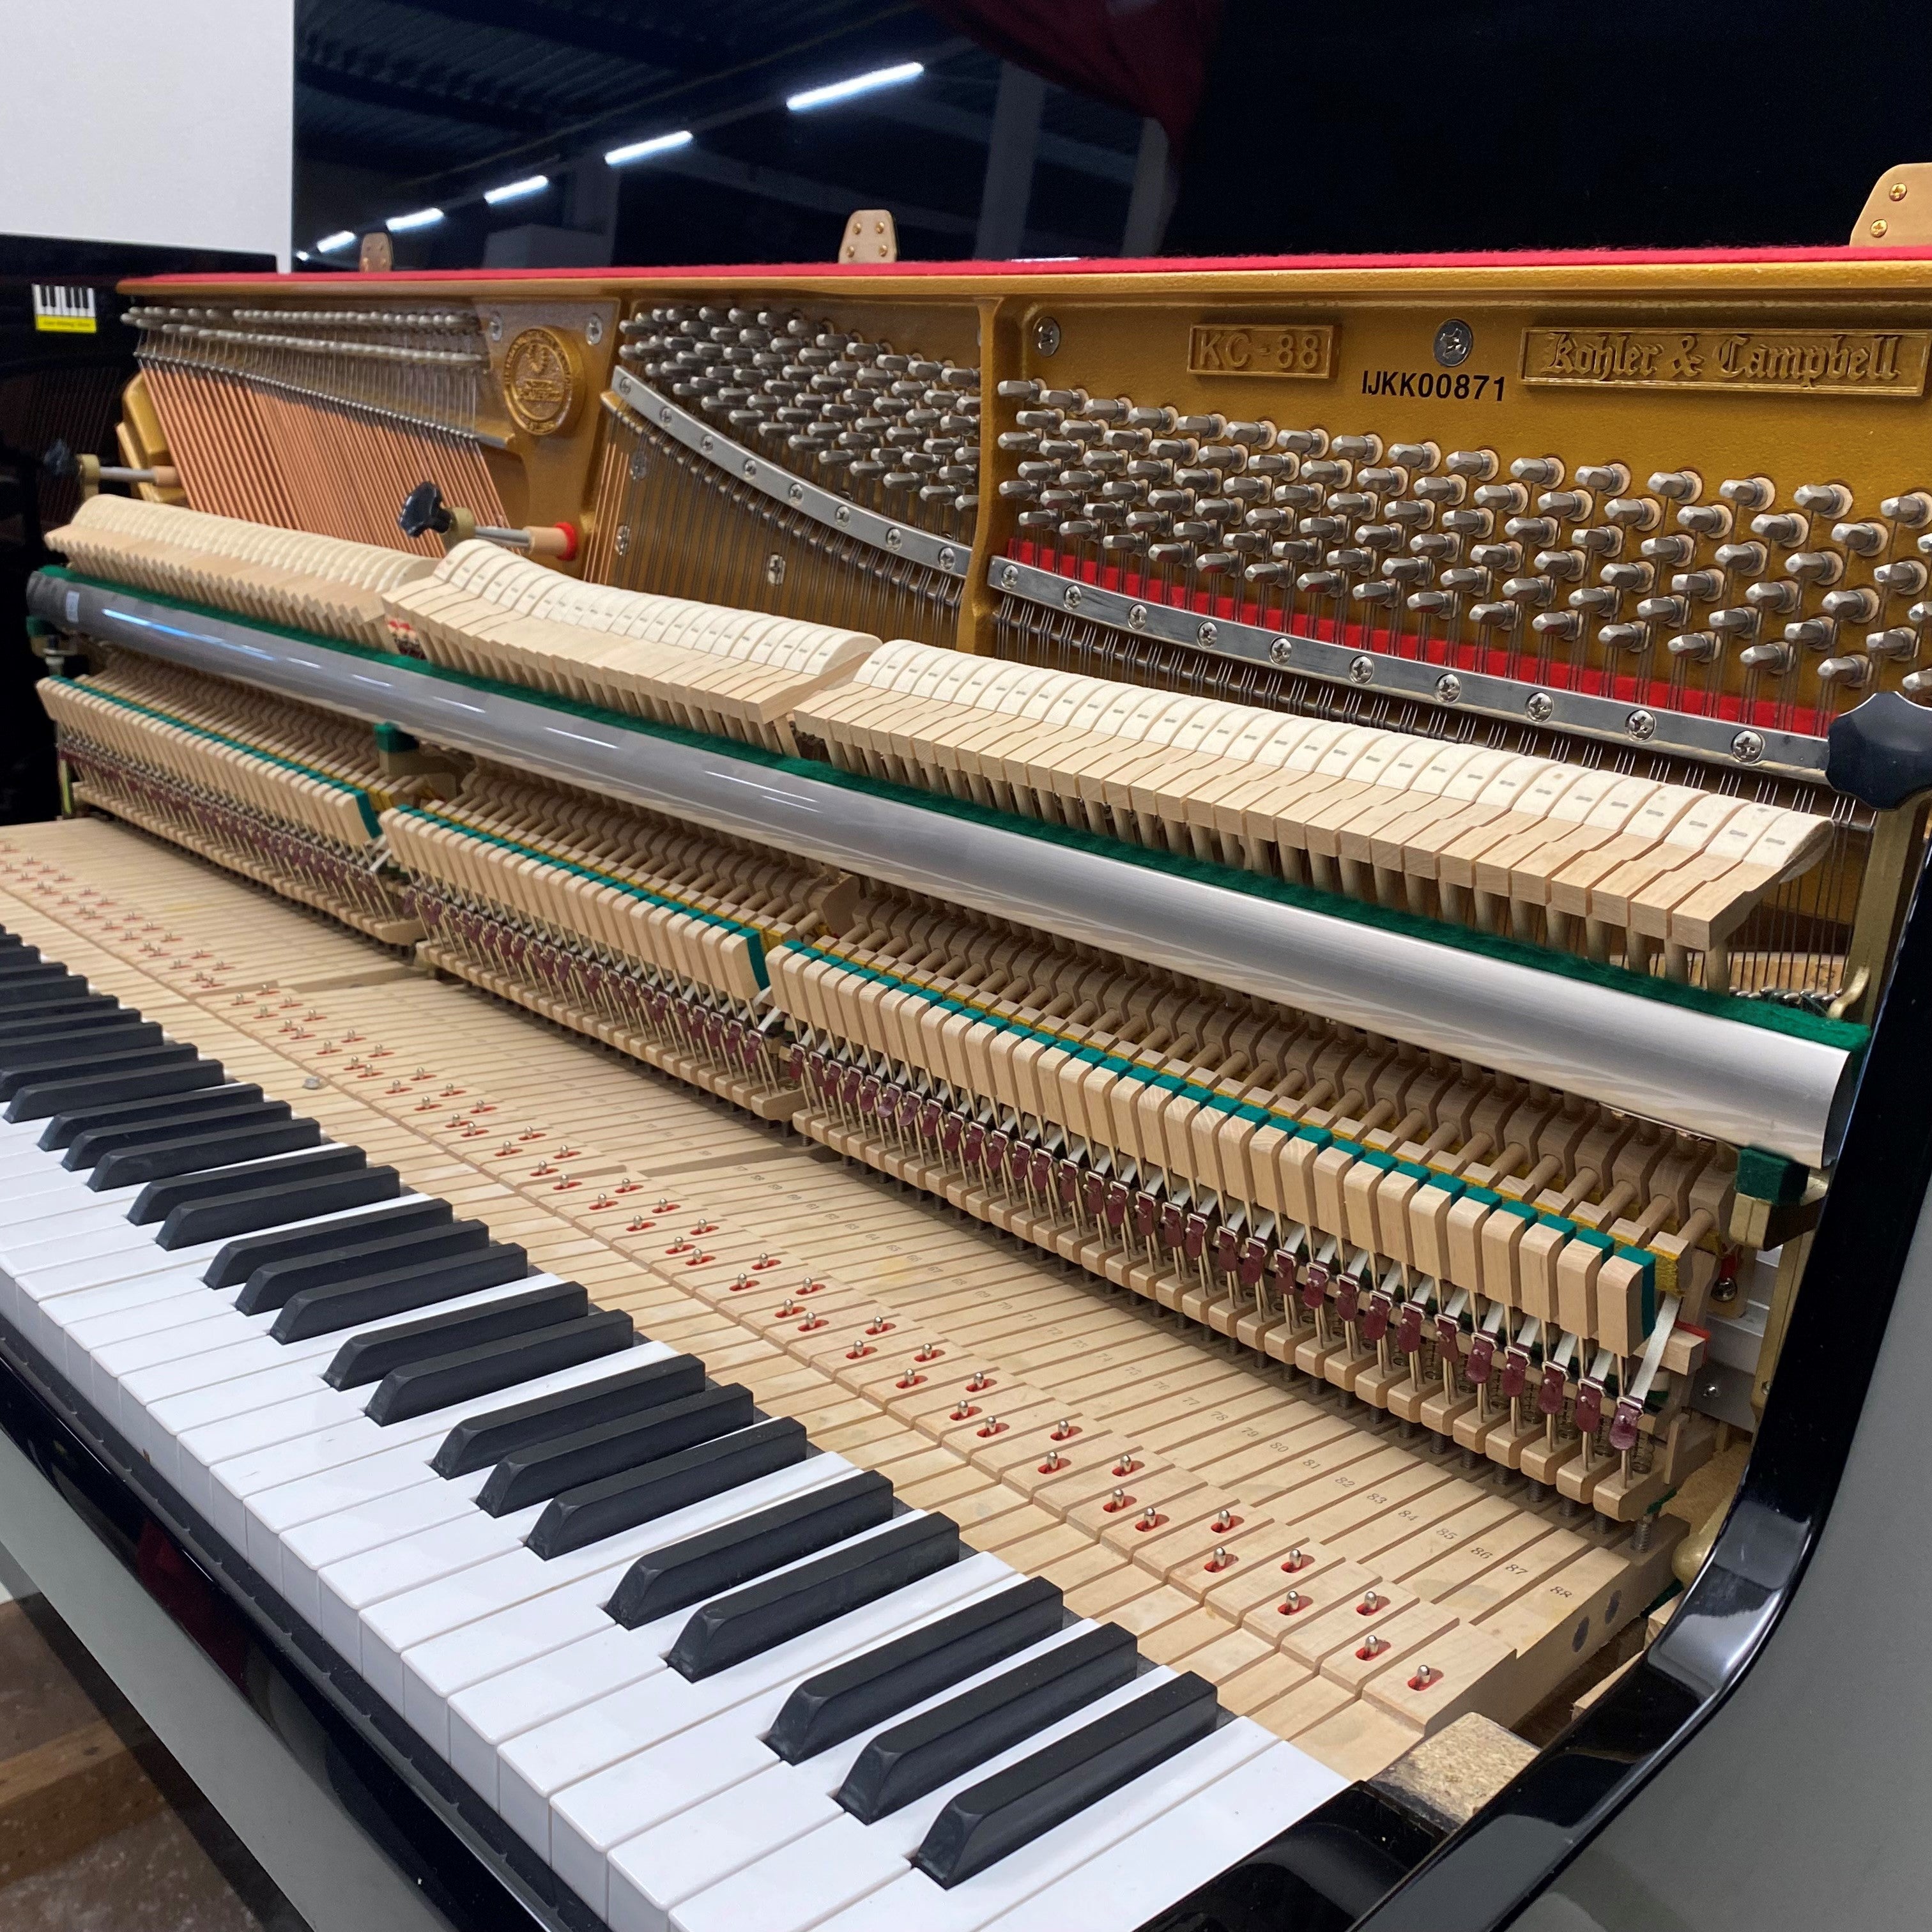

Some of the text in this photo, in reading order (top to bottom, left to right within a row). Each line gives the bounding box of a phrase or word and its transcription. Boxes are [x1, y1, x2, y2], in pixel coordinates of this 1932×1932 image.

[1199, 332, 1320, 370] KC-88
[1540, 331, 1903, 388] Kohler & Campbell
[1361, 370, 1505, 402] IJKK00871
[1047, 1327, 1063, 1335] 72
[1182, 1397, 1200, 1406] 77
[1210, 1411, 1229, 1421] 78
[1241, 1427, 1259, 1437] 79
[1269, 1442, 1289, 1452] 80
[1303, 1459, 1321, 1469] 81
[1335, 1477, 1355, 1488] 82
[1367, 1493, 1388, 1504] 83
[1398, 1510, 1419, 1521] 84
[1436, 1528, 1457, 1540] 85
[1471, 1547, 1493, 1559] 86
[1505, 1564, 1528, 1575] 87
